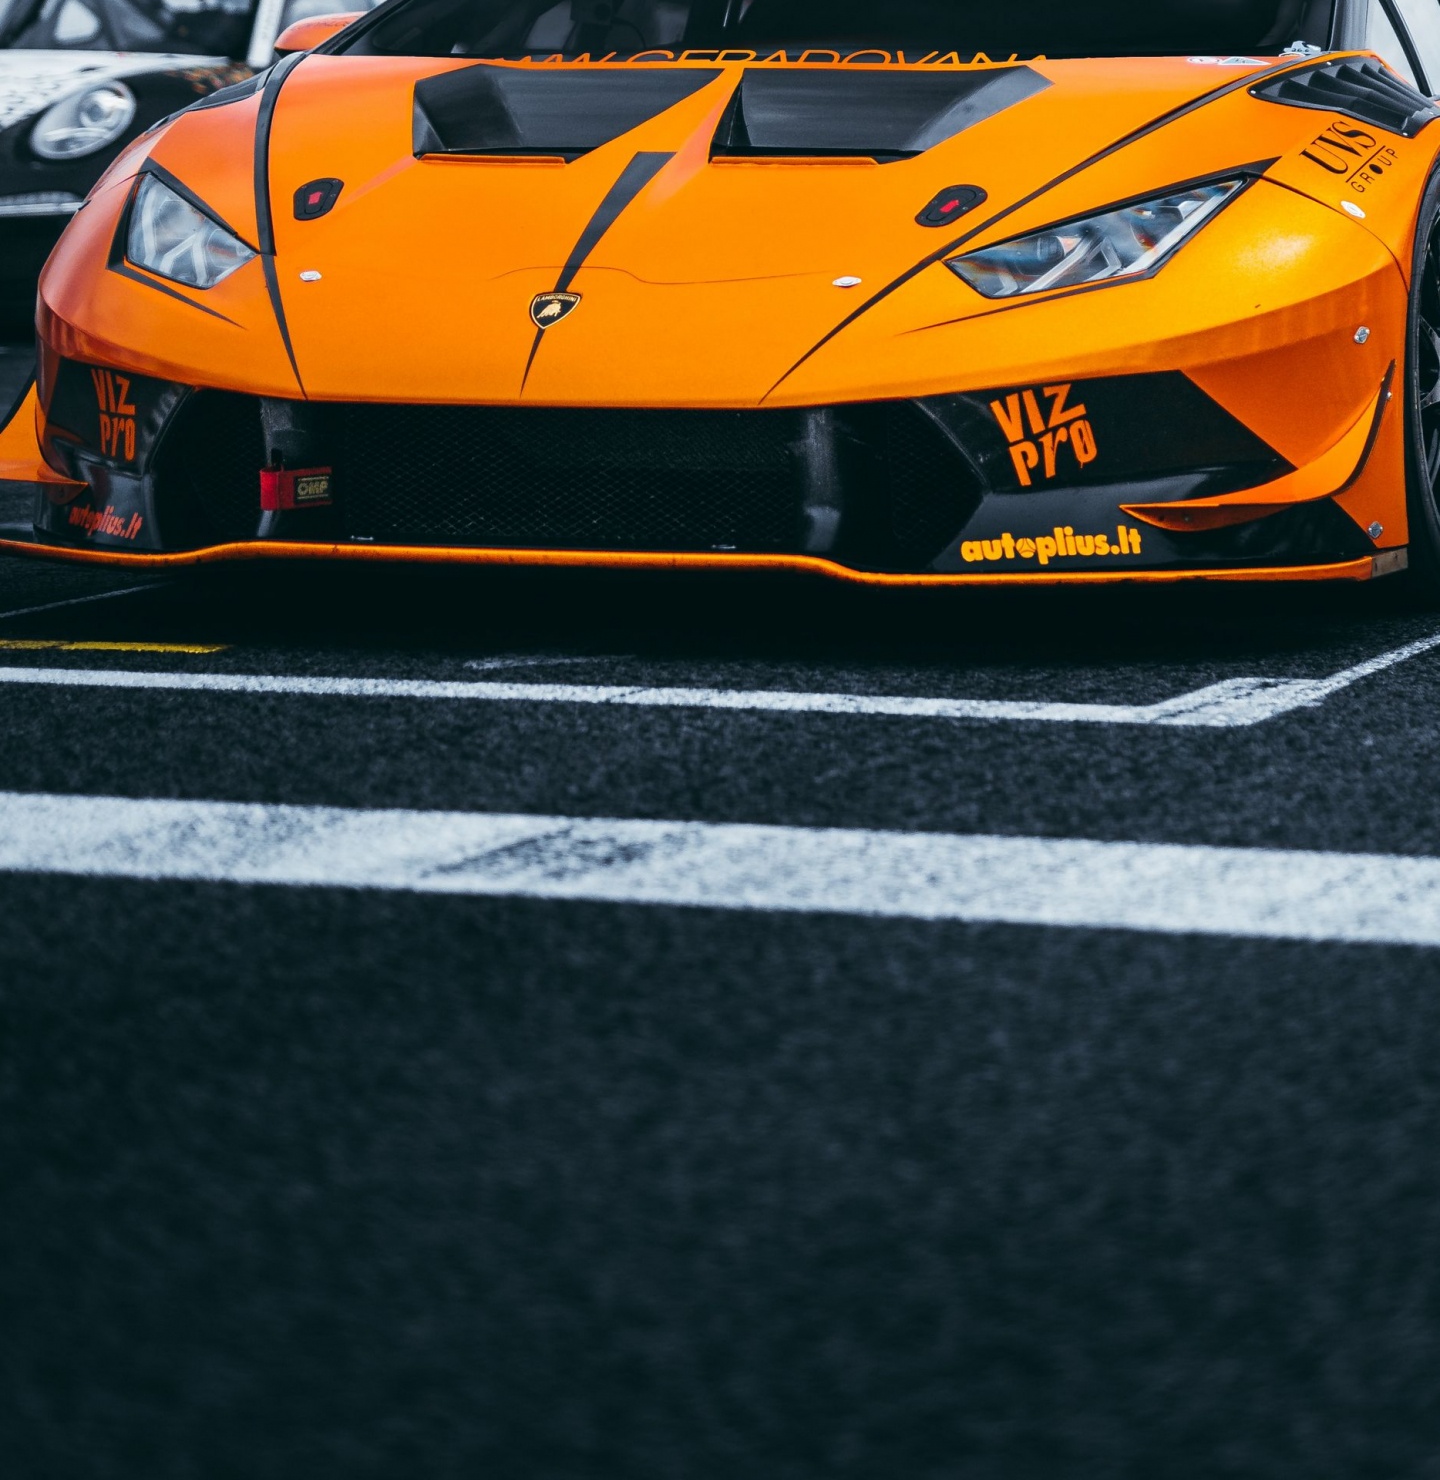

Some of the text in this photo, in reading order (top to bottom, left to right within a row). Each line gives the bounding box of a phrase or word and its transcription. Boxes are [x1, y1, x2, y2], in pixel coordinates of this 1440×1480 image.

[1299, 120, 1377, 175] UVS
[91, 369, 136, 416] VIZ
[990, 383, 1087, 443] VIZ
[297, 480, 329, 496] OMP
[961, 525, 1142, 566] autoplius.lt
